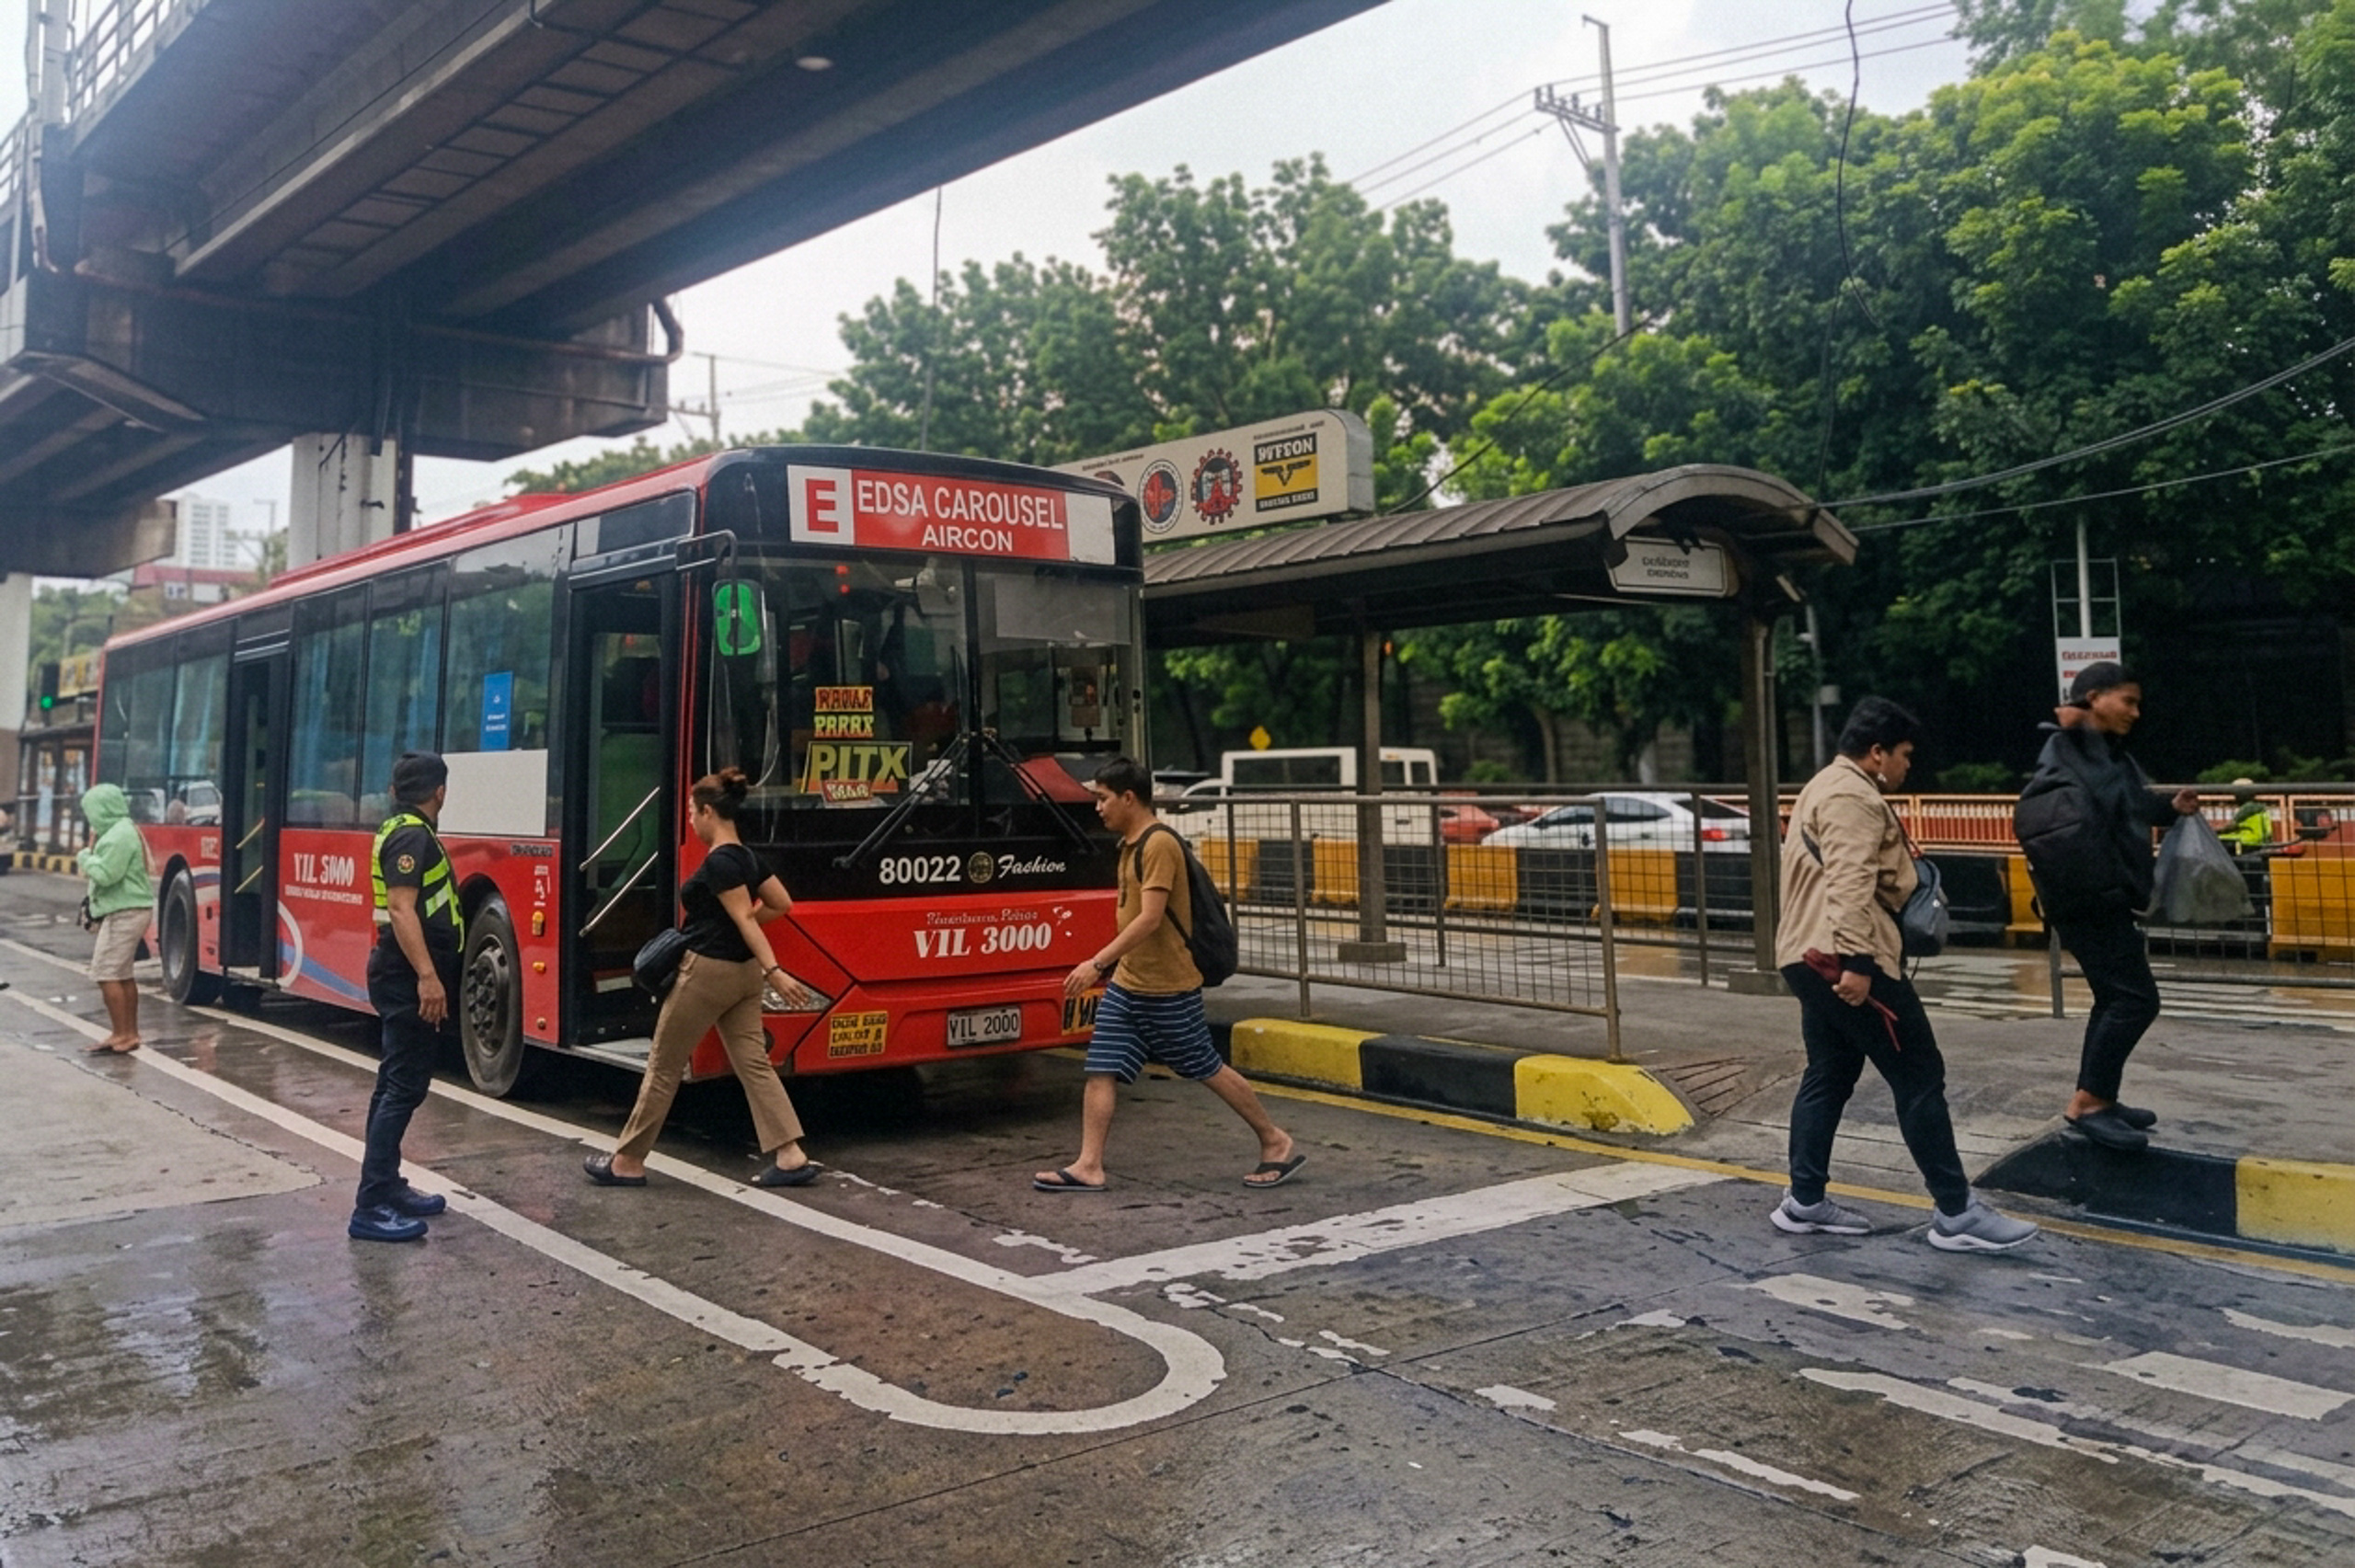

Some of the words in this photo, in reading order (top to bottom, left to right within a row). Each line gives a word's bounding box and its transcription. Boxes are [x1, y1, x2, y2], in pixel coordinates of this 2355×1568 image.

[805, 477, 840, 533] E
[856, 479, 928, 518] EDSA
[934, 486, 1064, 530] CAROUSEL
[921, 524, 1013, 552] AIRCON
[808, 744, 909, 793] PITX
[879, 855, 961, 884] 80022
[997, 853, 1067, 879] Fashion
[913, 928, 971, 958] VIL
[980, 922, 1052, 955] 3000
[983, 1013, 1018, 1035] 2000
